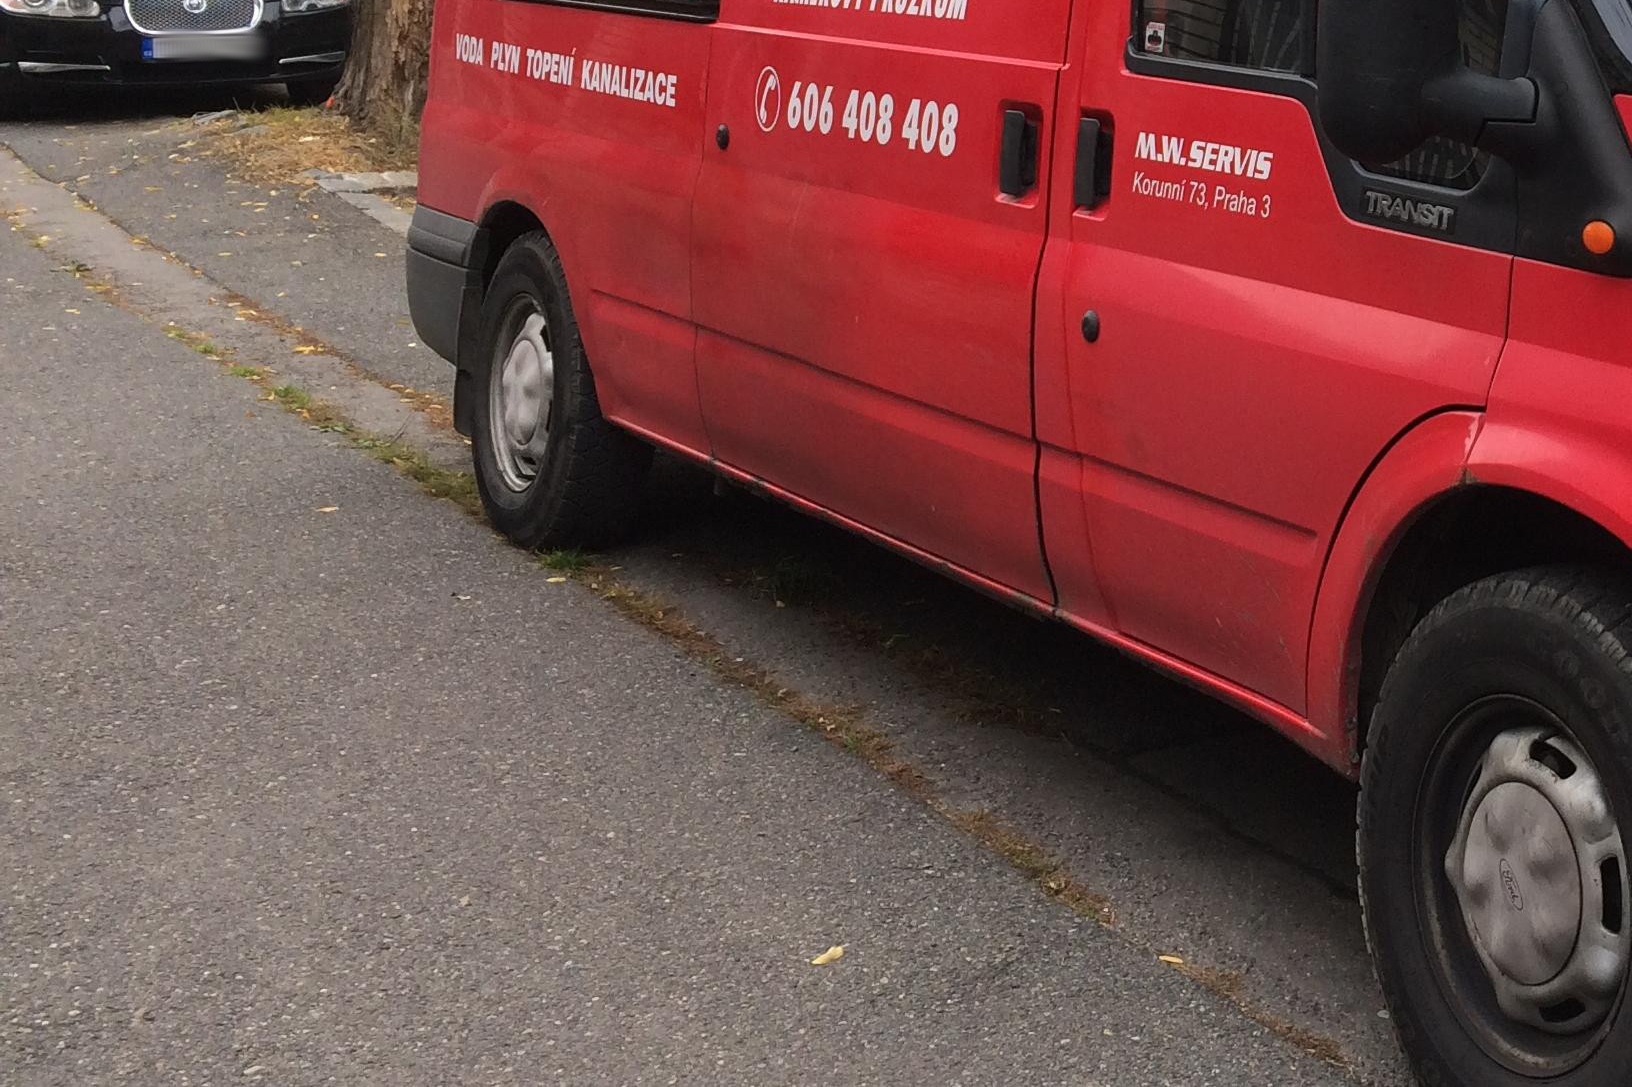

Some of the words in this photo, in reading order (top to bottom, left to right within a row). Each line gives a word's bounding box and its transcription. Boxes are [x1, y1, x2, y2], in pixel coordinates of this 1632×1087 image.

[456, 32, 484, 66] VODA
[490, 40, 521, 74] PLYN
[526, 47, 577, 86] TOPENÍ
[580, 58, 678, 108] KANALIZACE
[787, 81, 834, 135] 606
[842, 89, 894, 145] 408
[902, 98, 959, 157] 408
[1132, 171, 1185, 202] Korunní
[1189, 180, 1208, 211] 73,
[1213, 188, 1256, 216] Praha
[1260, 194, 1271, 218] 3
[1366, 190, 1455, 231] TRANSIT
